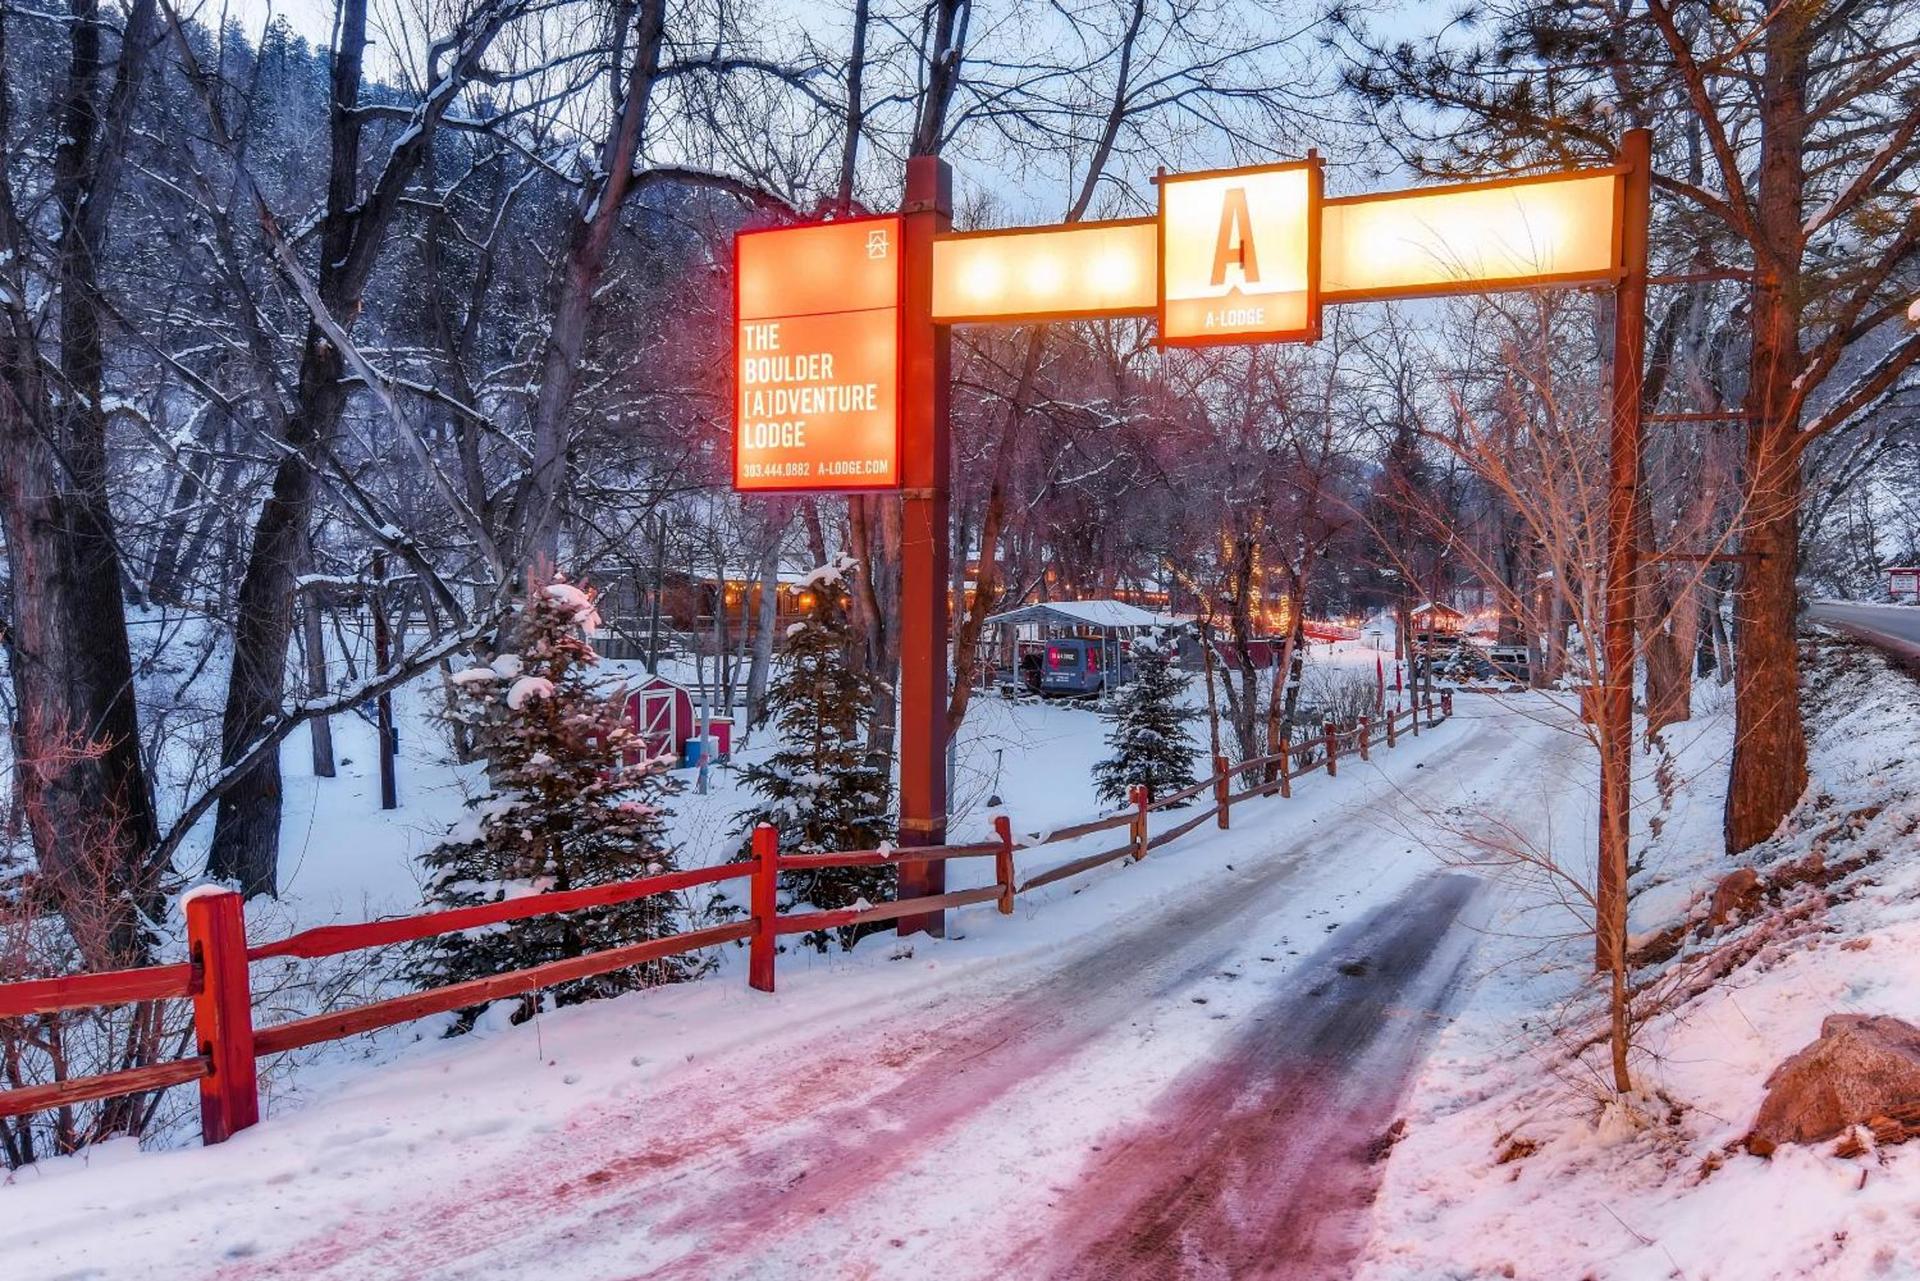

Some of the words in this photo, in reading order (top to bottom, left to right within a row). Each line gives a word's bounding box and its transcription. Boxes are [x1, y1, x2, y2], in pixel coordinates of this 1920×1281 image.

[1210, 188, 1260, 286] A
[1205, 308, 1265, 328] A-LODGE
[744, 324, 780, 350] THE
[745, 353, 833, 384] BOULDER
[744, 384, 877, 418] [A]DVENTURE
[744, 422, 806, 449] LODGE
[743, 463, 810, 478] 303.444.0882
[818, 459, 888, 475] A-LODGE.COM
